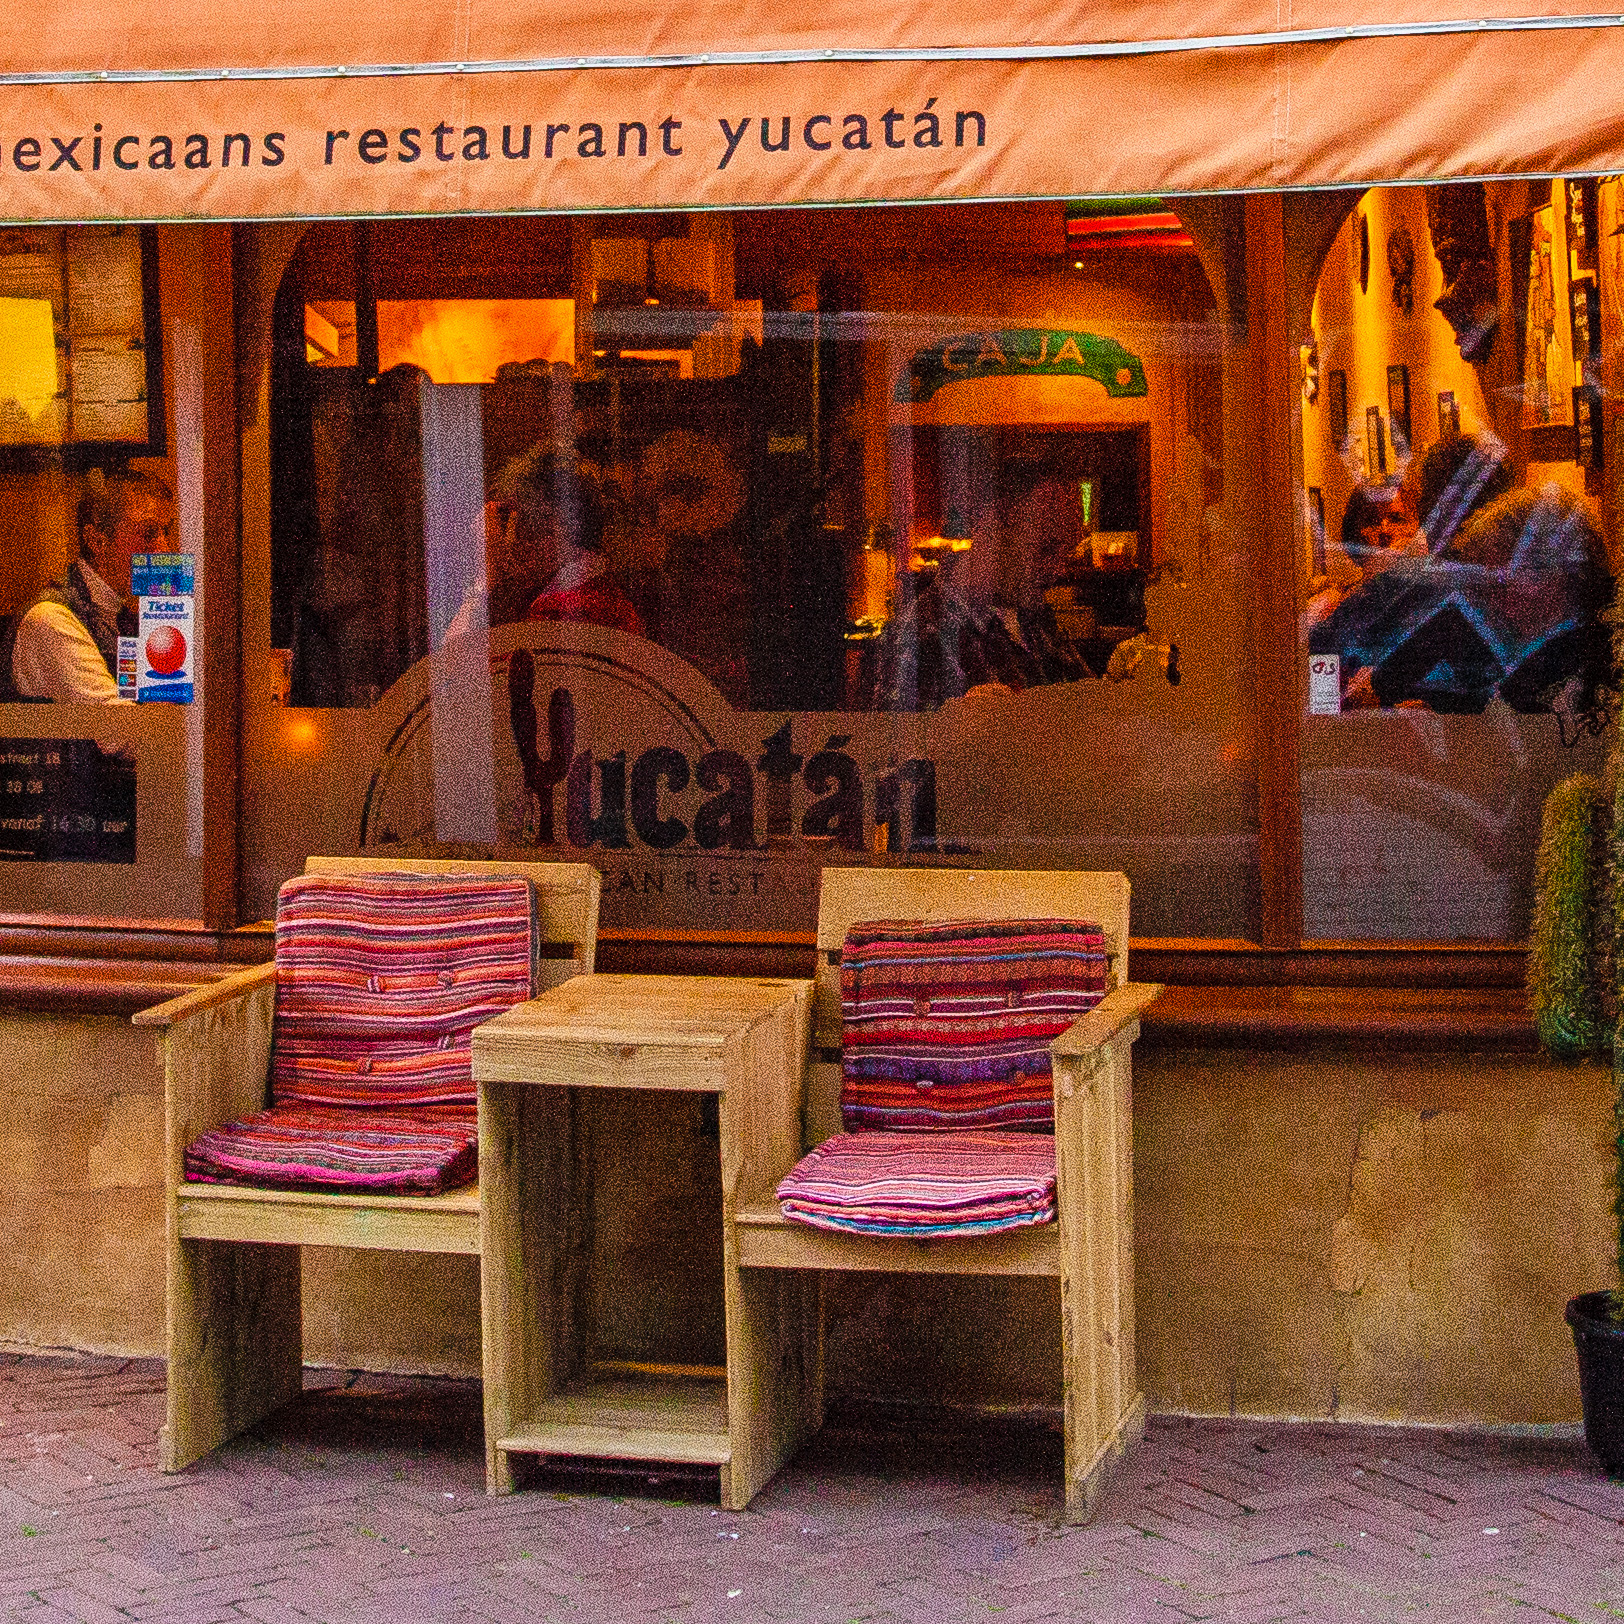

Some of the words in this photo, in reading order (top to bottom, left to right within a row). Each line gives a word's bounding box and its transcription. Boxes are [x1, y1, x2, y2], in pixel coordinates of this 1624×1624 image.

[323, 115, 684, 166] restaurant
[715, 96, 988, 171] yucatán
[942, 334, 1086, 372] CAJA
[147, 600, 185, 612] Ticket
[507, 647, 938, 853] Yucatán
[0, 814, 45, 831] vanaf
